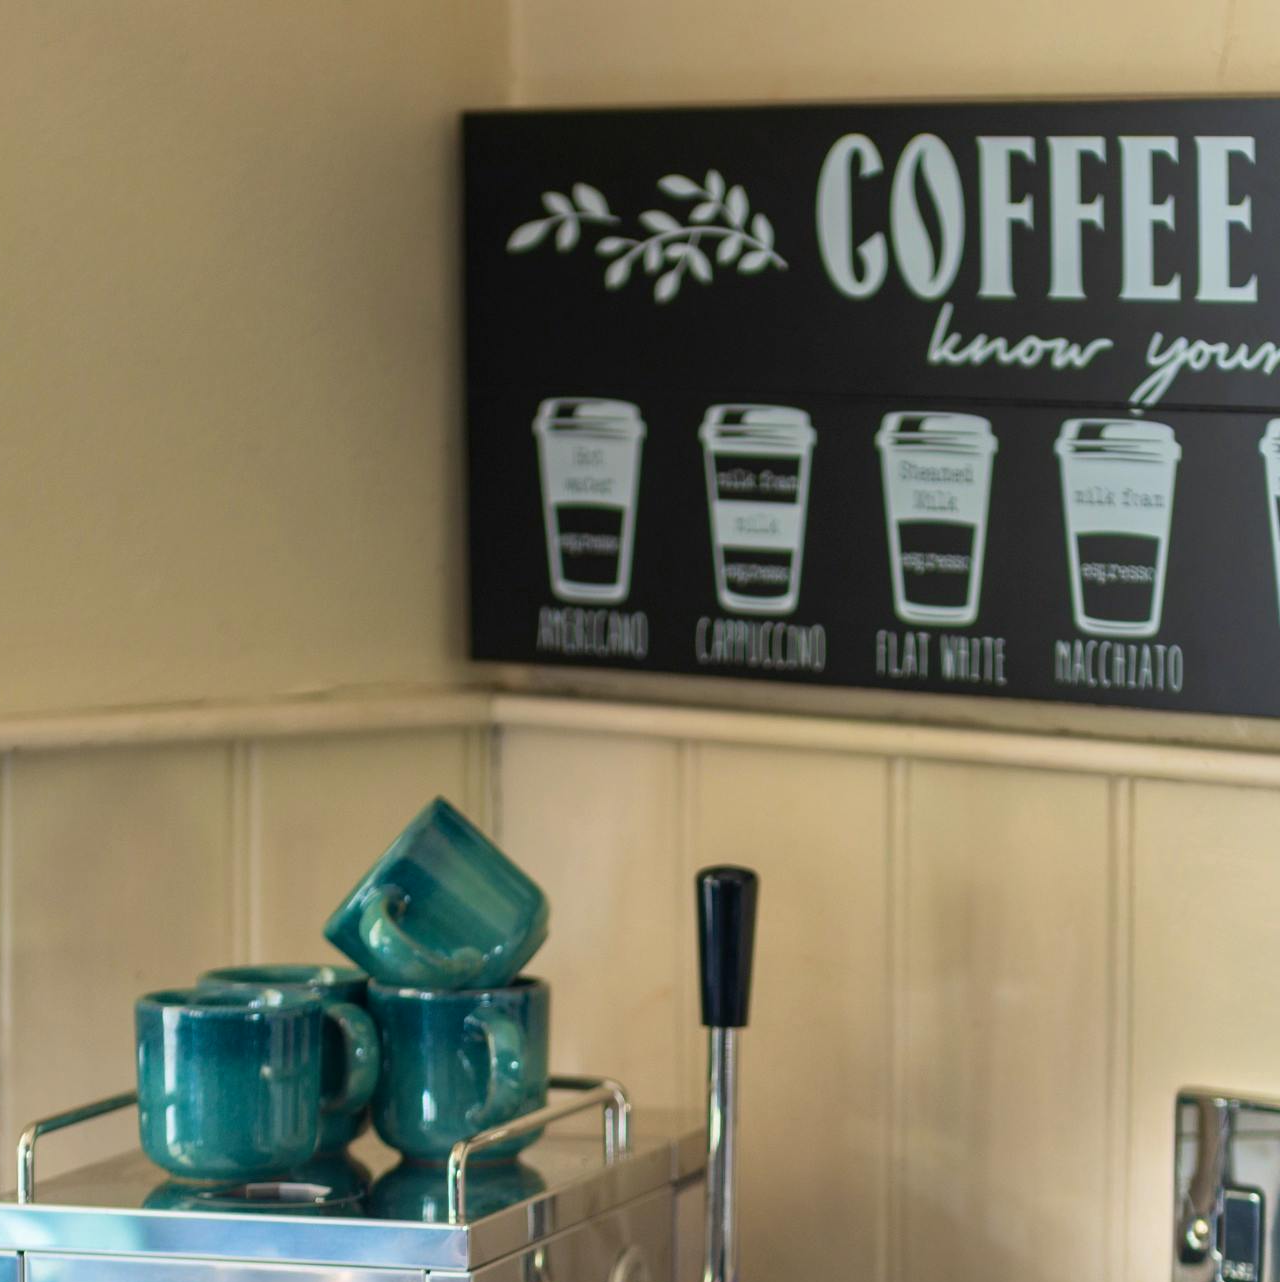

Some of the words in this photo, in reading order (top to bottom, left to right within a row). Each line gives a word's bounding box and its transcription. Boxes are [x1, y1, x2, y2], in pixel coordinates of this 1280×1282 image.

[816, 131, 1258, 302] COFFEE
[927, 301, 1113, 367] know
[875, 629, 931, 679] FLAT
[1054, 639, 1184, 693] MACCHIATO
